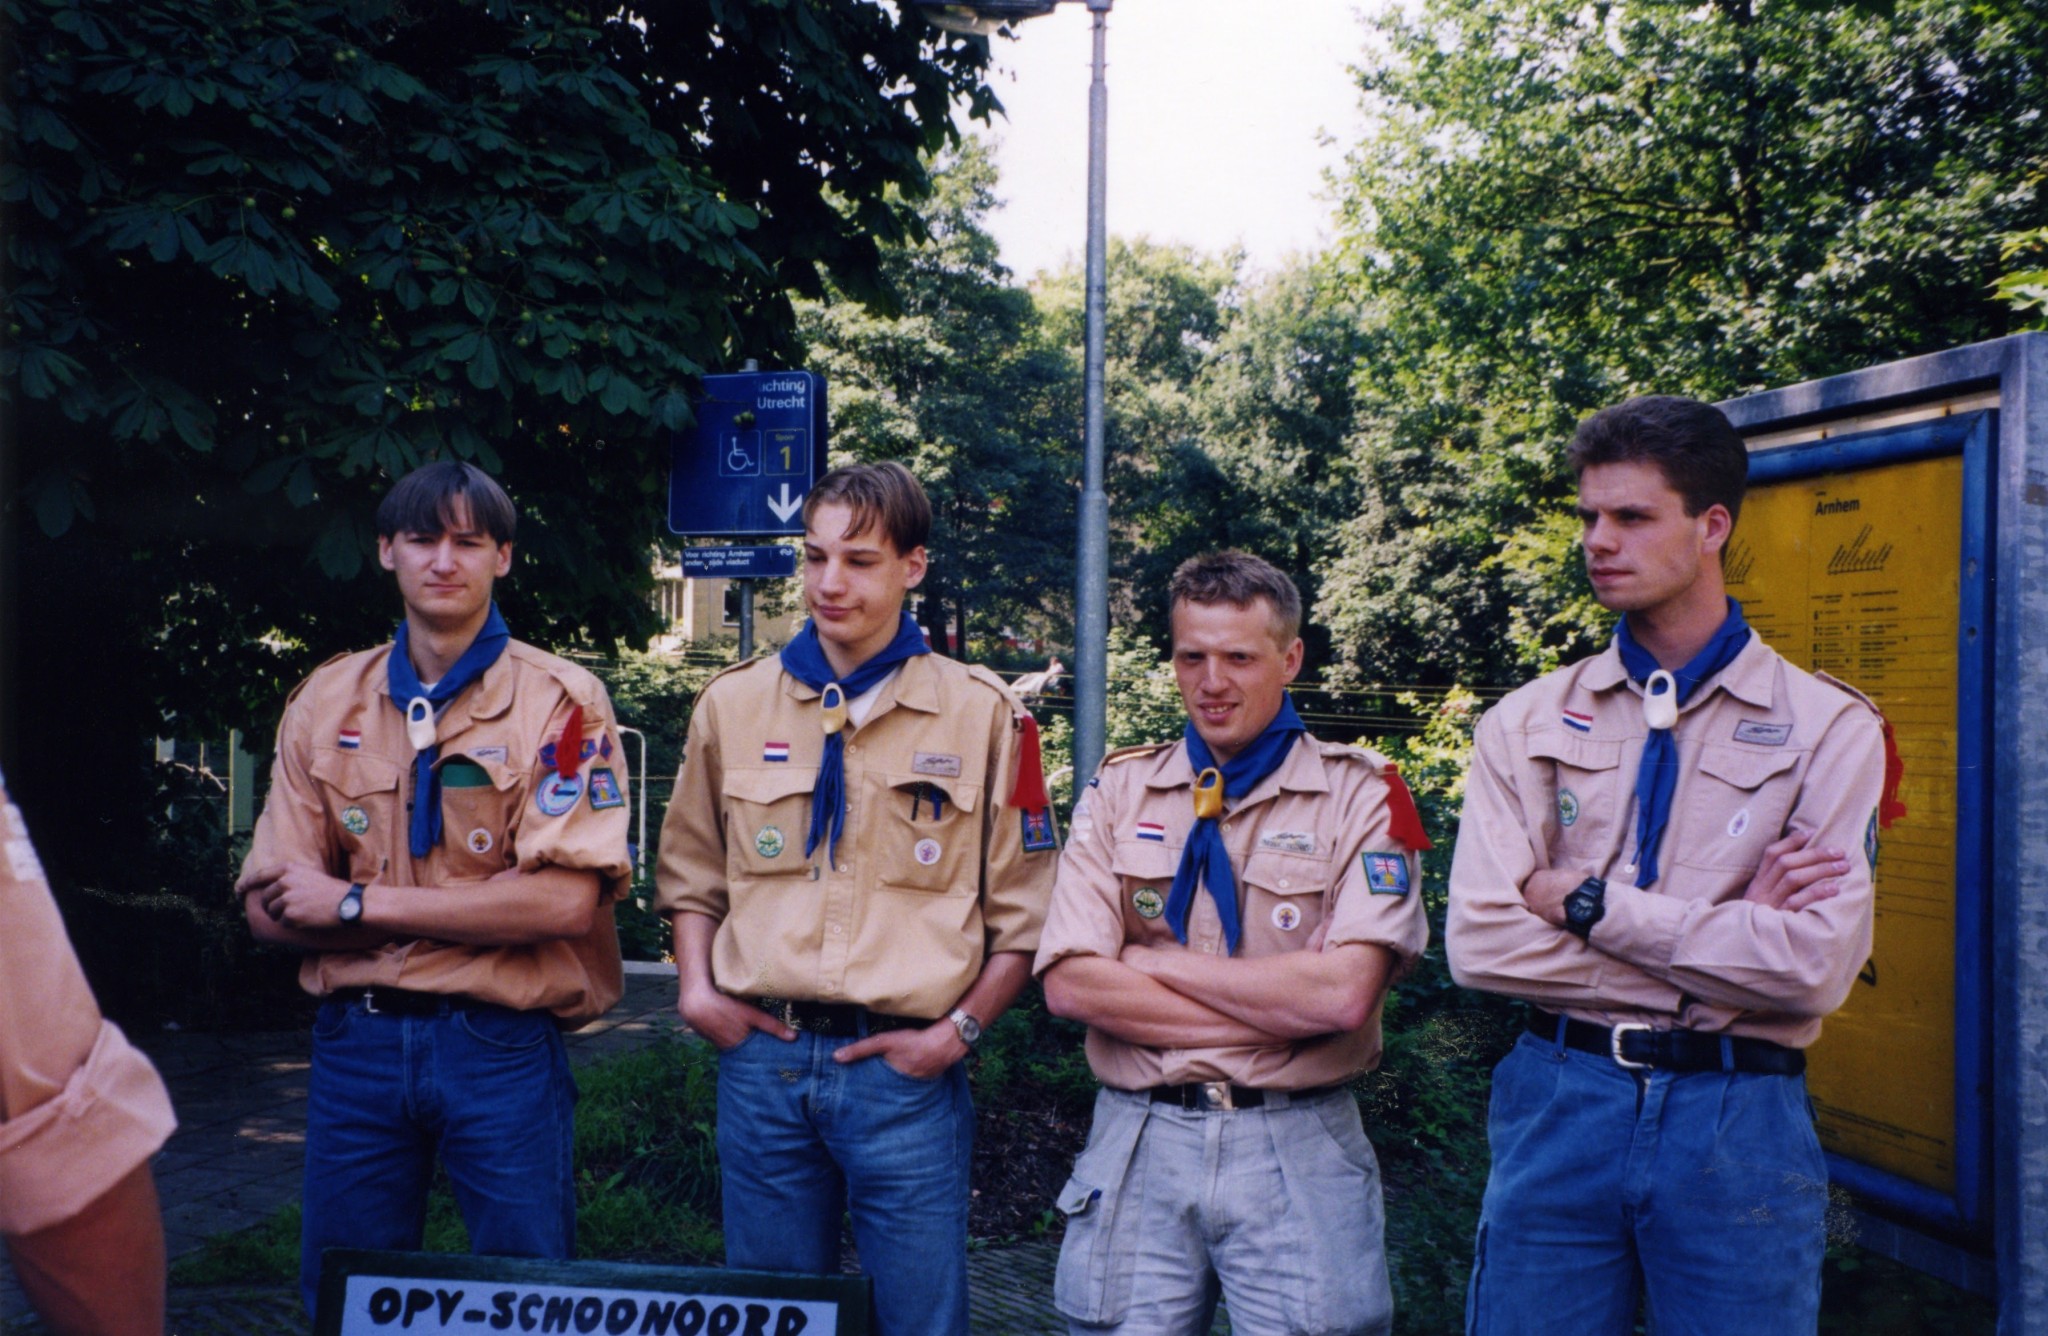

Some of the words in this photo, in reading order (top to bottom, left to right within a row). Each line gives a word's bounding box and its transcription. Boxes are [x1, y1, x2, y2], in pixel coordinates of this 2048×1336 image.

[757, 379, 805, 394] ichting
[757, 396, 805, 409] Utrecht
[780, 446, 790, 470] 1
[1815, 498, 1860, 516] Arnhem
